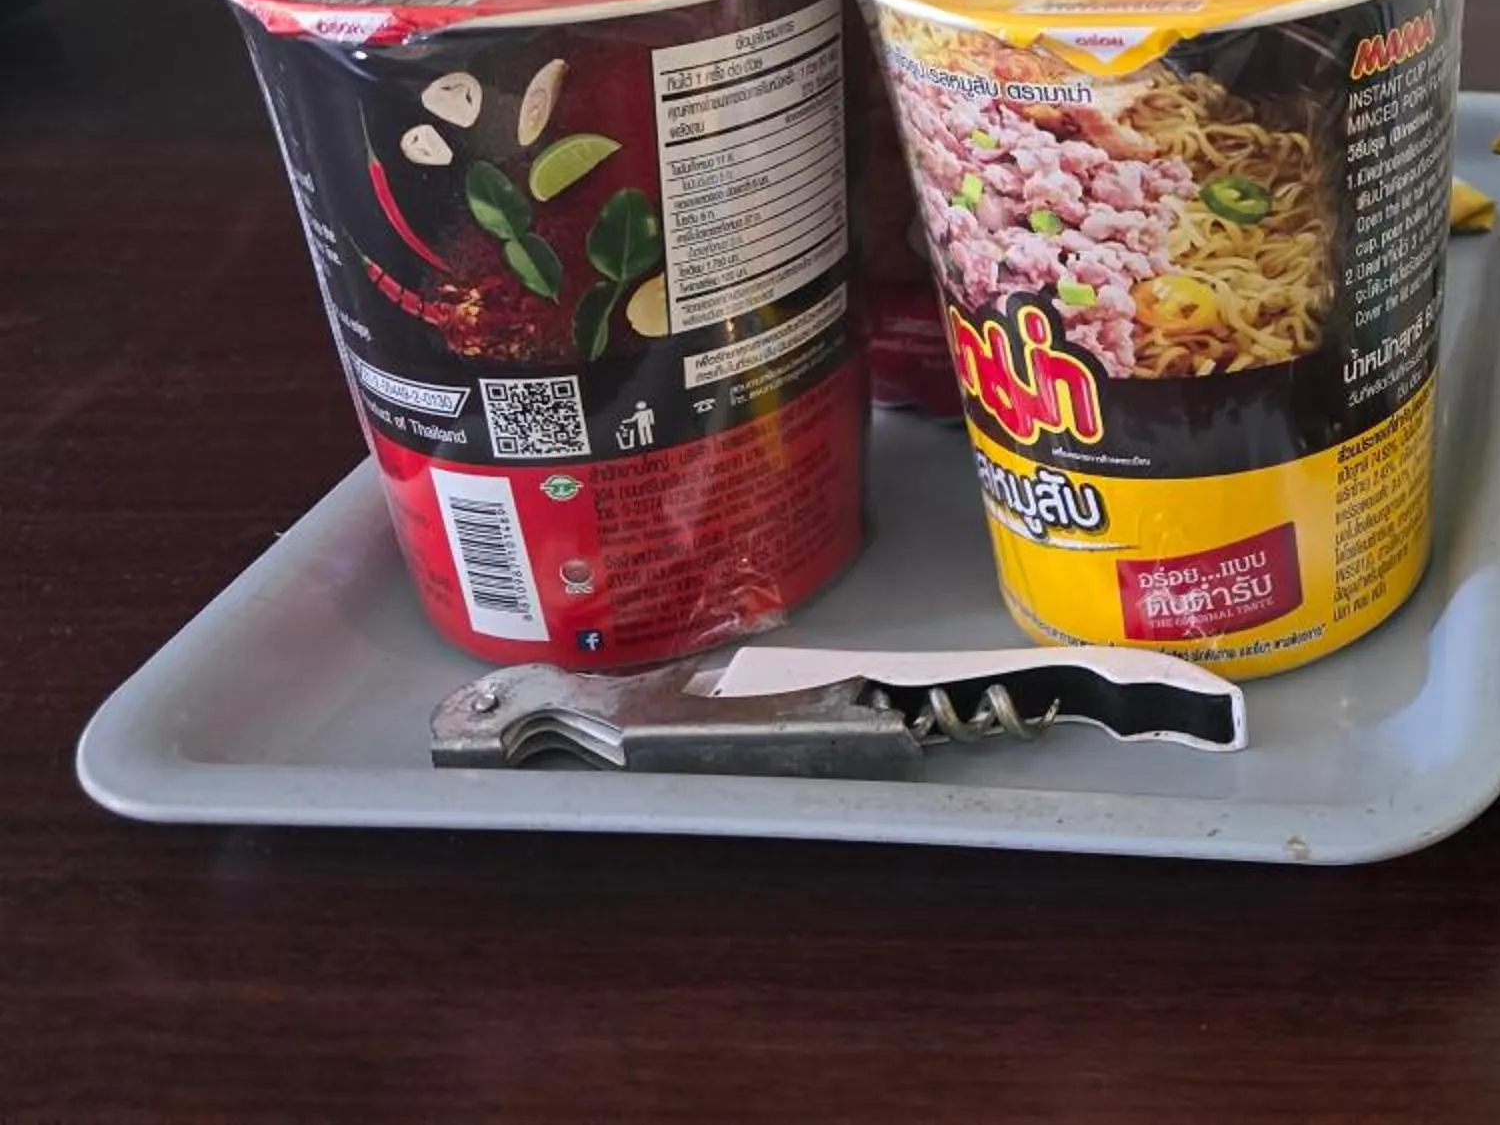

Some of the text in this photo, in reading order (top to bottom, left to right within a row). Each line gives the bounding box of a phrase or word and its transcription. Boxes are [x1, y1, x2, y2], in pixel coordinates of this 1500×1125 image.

[1350, 9, 1436, 81] MAMA
[1007, 82, 1092, 104] ตรามาม่า
[1349, 73, 1402, 111] INSTANT
[949, 305, 1104, 445] าม่า
[408, 418, 467, 444] Thailand
